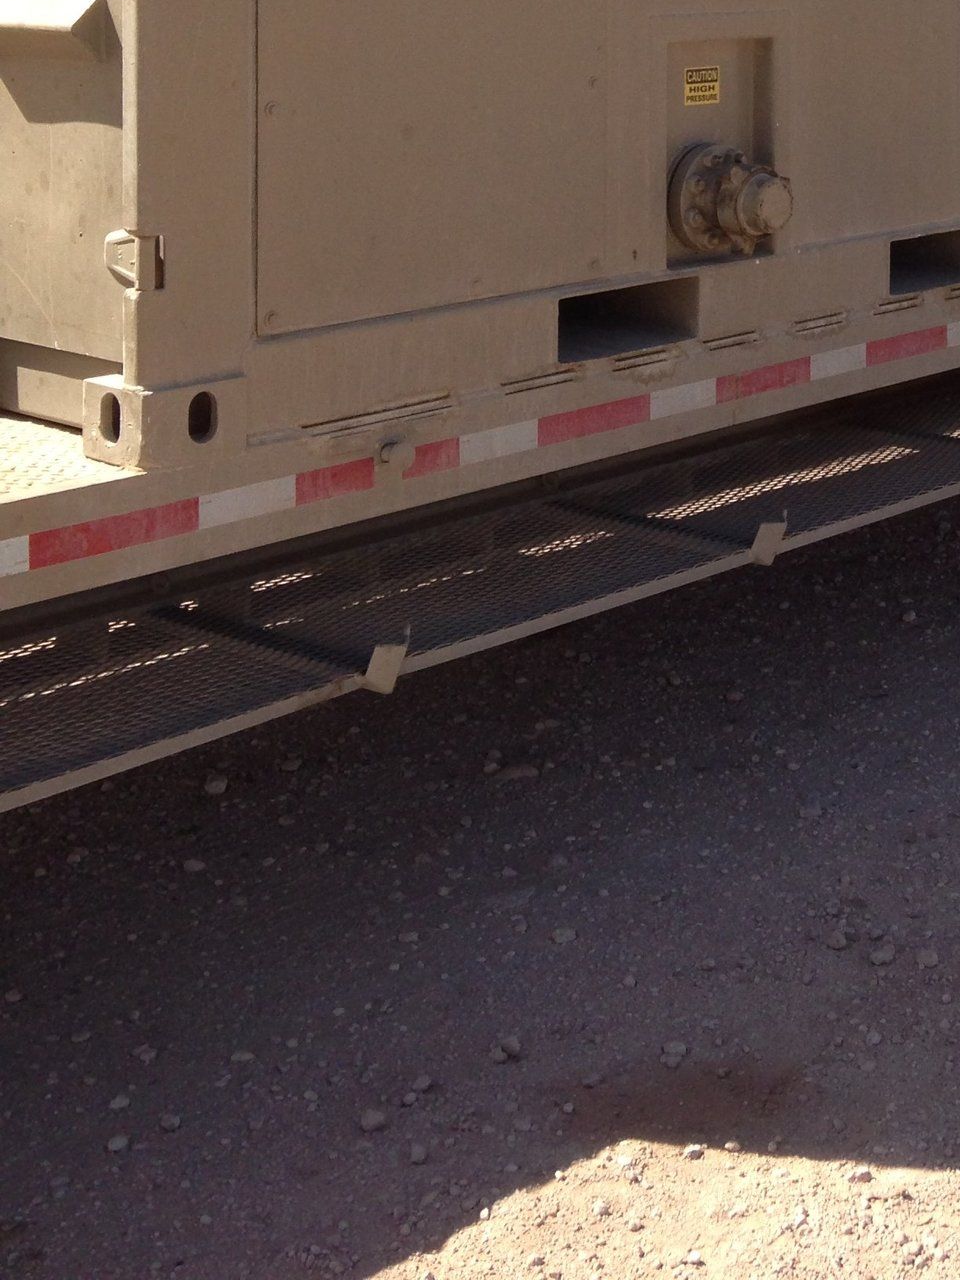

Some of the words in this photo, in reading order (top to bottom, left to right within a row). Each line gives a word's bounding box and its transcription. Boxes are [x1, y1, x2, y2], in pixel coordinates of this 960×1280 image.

[687, 70, 718, 82] CAUTION
[689, 84, 715, 93] HIGH
[686, 93, 718, 103] PRESSURE
